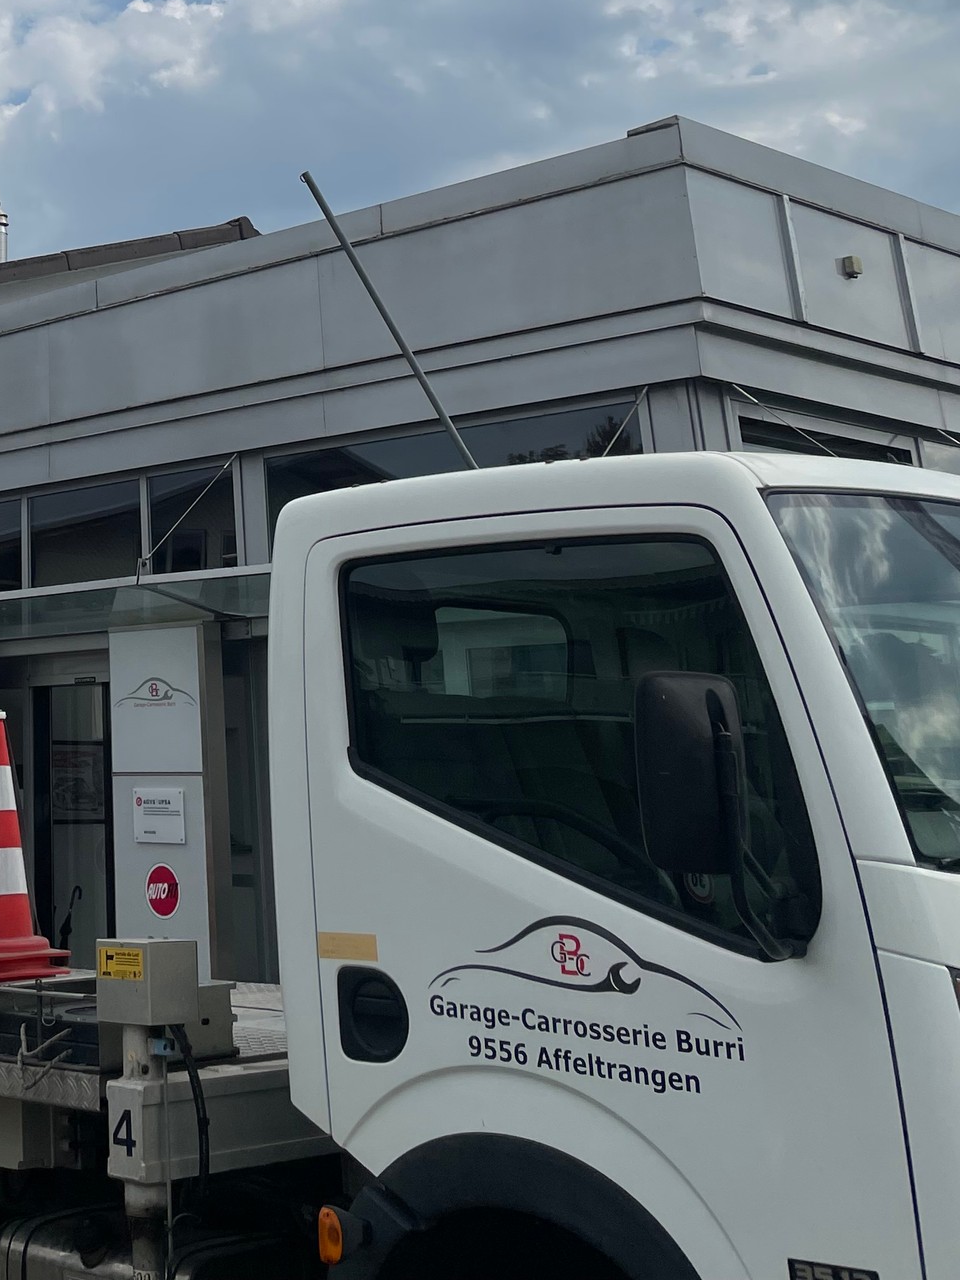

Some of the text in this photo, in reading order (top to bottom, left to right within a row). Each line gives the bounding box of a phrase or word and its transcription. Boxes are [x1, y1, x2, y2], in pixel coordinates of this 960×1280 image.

[429, 994, 745, 1062] Garage-Carrosserie Burri
[468, 1035, 701, 1094] 9556 Affeltrangen
[112, 1109, 137, 1157] 4
